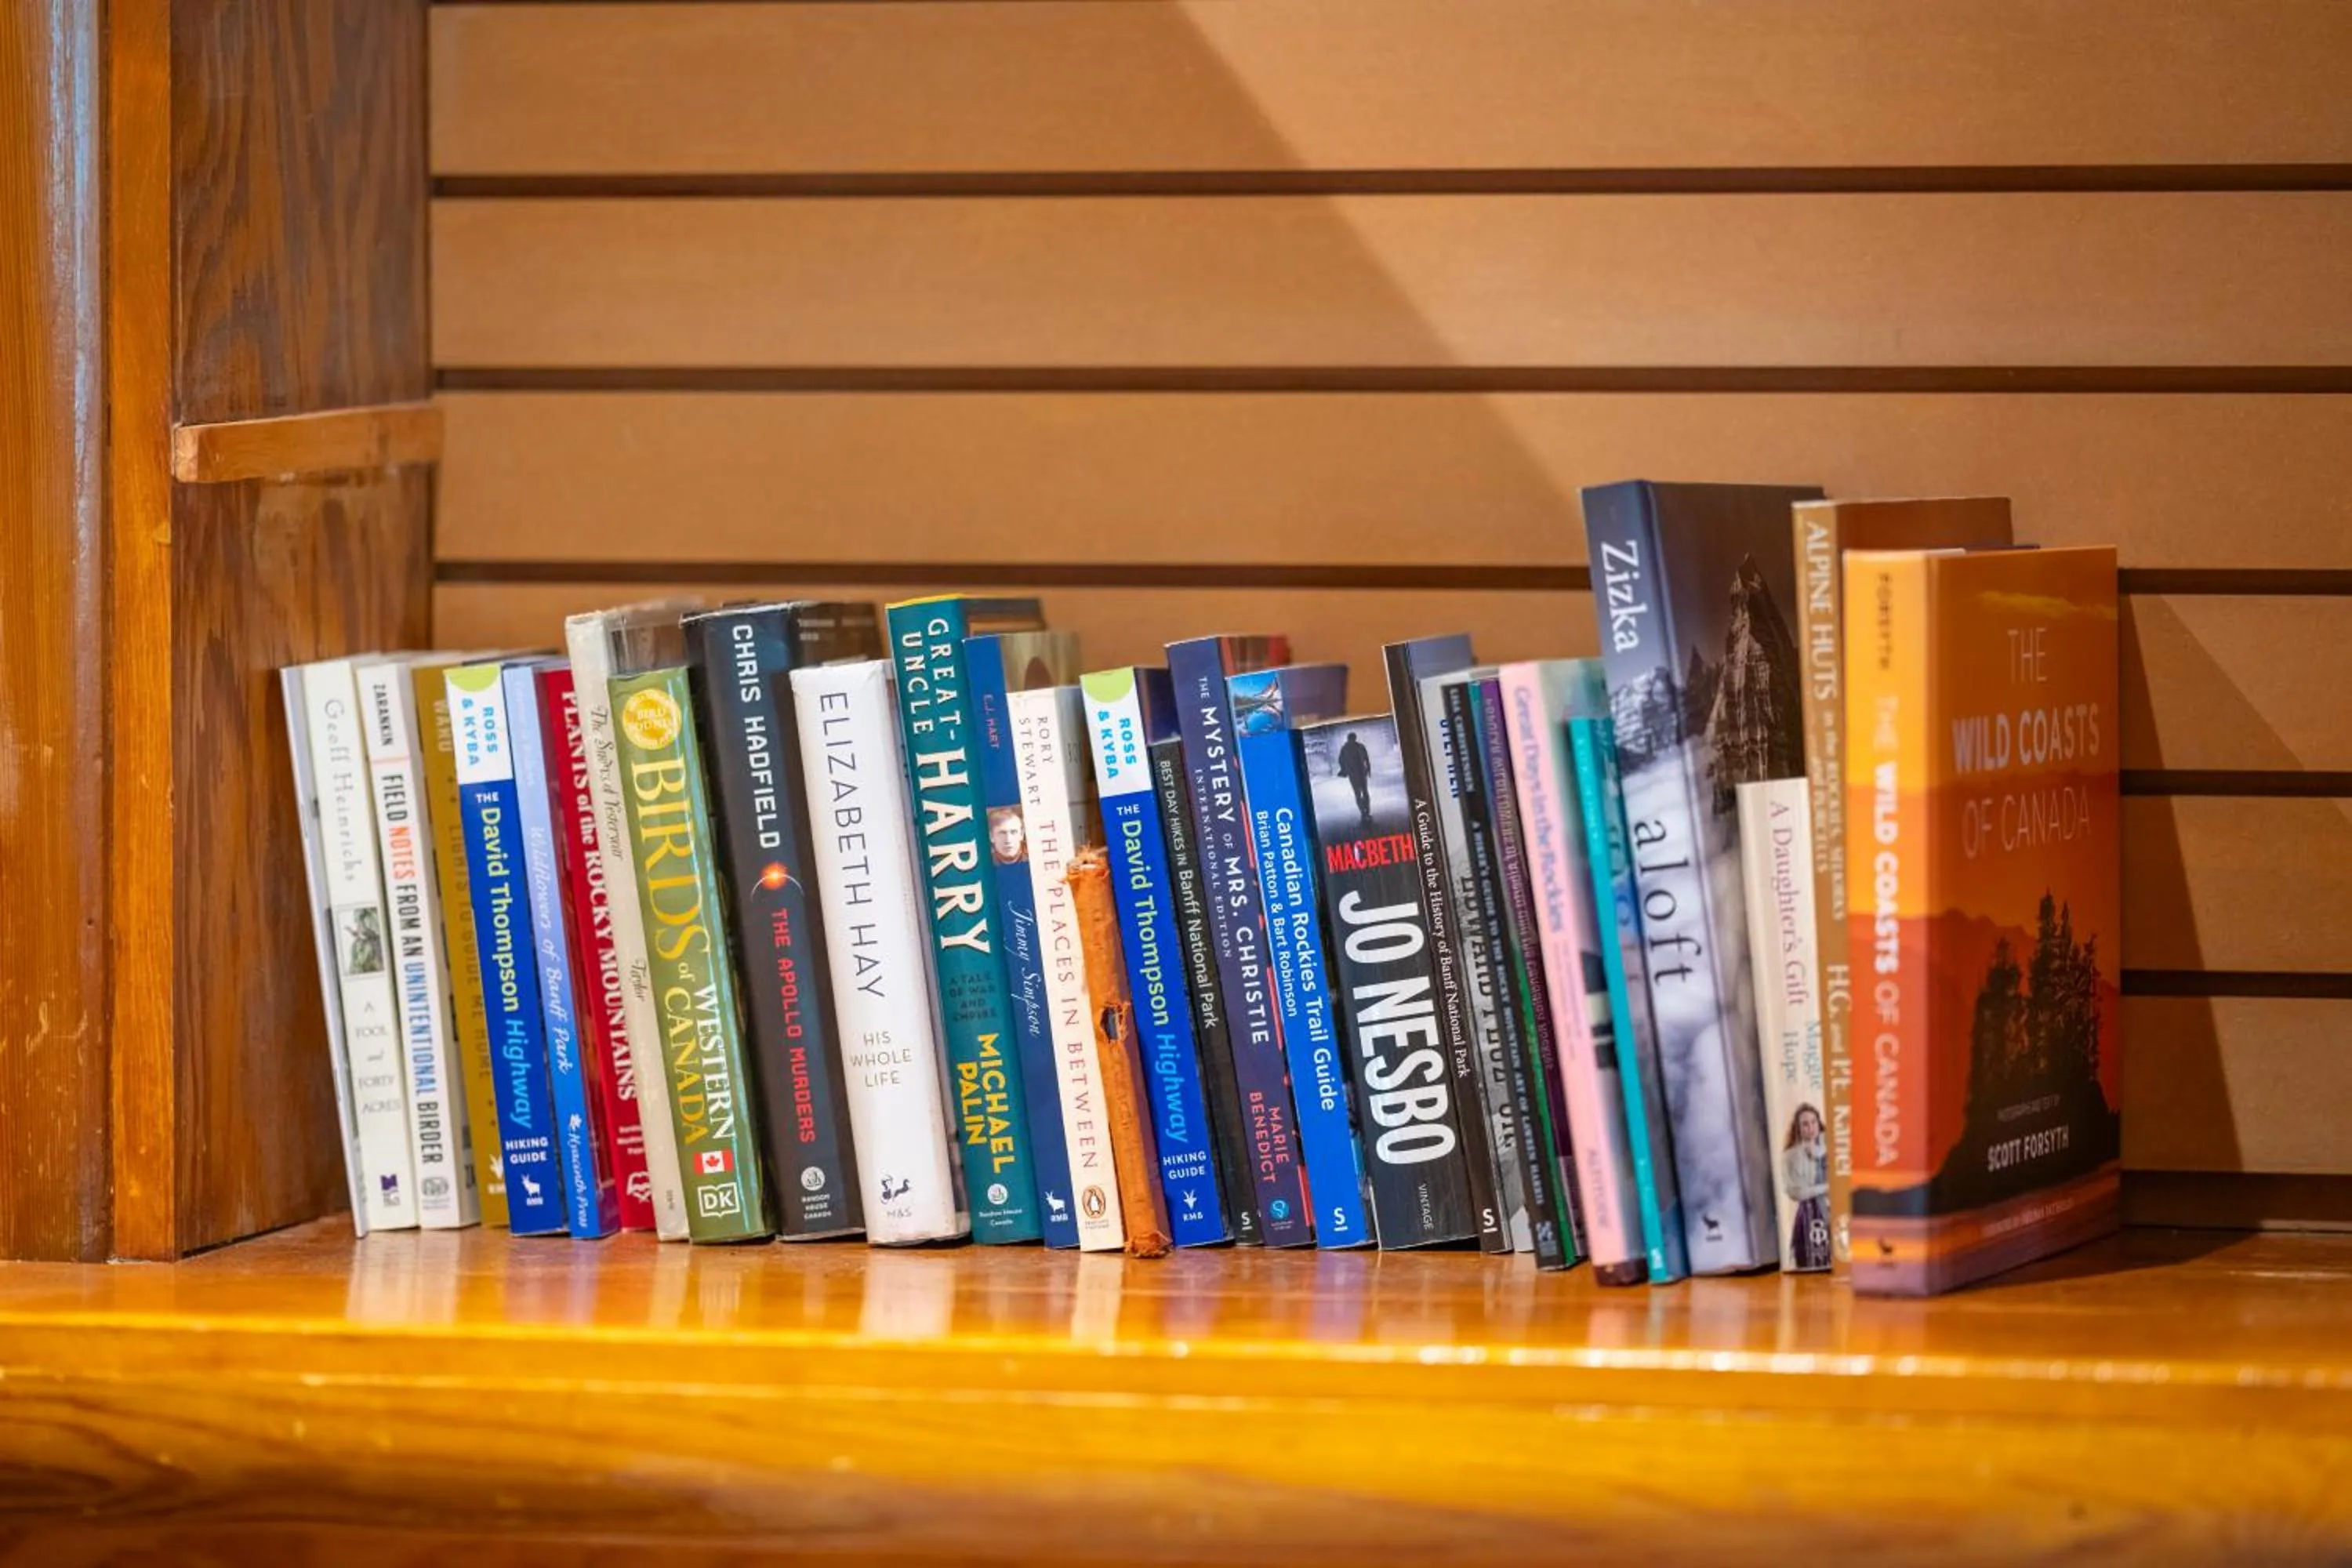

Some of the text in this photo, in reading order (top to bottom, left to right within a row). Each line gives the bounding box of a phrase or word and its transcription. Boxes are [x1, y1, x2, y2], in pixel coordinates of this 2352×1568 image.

[1600, 539, 1648, 653] Zizka
[1806, 521, 1838, 702] ALPINE HUTS
[901, 631, 935, 735] UNCLE
[927, 618, 964, 741] GREAT-
[2007, 627, 2048, 684] THE
[372, 684, 394, 746] ZARANKIN
[463, 698, 480, 766] & KYBA
[483, 706, 498, 753] ROSS
[561, 691, 588, 789] PLANTS
[732, 624, 781, 849] CHRIS HADFIELD
[986, 719, 1000, 750] HART
[1037, 717, 1054, 765] RORY
[1098, 710, 1119, 779] & KYBA
[1119, 718, 1137, 765] ROSS
[1450, 688, 1475, 793] LISA CHRISTENSEN
[1951, 702, 2100, 775] WILD COASTS
[325, 699, 362, 882] Geoff Heinrichs
[1020, 718, 1040, 806] STEWART
[382, 774, 408, 821] FIELD
[476, 792, 499, 804] THE
[577, 795, 593, 812] of
[1116, 804, 1140, 816] THE
[1962, 786, 2091, 860] OF CANADA
[389, 827, 415, 880] NOTES
[579, 815, 596, 845] the
[820, 691, 885, 998] ELIZABETH HAY
[915, 746, 993, 955] HARRY
[1197, 676, 1269, 1045] THE MYSTERY OF MRS. CHRISTIE
[1326, 833, 1419, 874] MACBETH
[1475, 831, 1490, 879] HIKER'S
[631, 753, 710, 959] BIRDS
[678, 962, 694, 982] of
[1195, 769, 1232, 958] INTERNATIONAL EDITION
[395, 884, 421, 931] FROM
[584, 851, 613, 938] ROCKY
[1160, 760, 1219, 1029] BEST DAY HIKES IN Banff National Park
[1255, 810, 1298, 1018] Brian Patton & Bart Robinson
[1482, 880, 1496, 916] GUIDE
[1633, 819, 1701, 986] aloft
[1769, 801, 1804, 1007] A Daughter's Gift
[401, 935, 423, 956] AN
[530, 826, 573, 1076] Wildflowers of Banff Park
[1414, 798, 1472, 1079] A Guide to the History of Banff National Park
[1489, 920, 1499, 936] TO
[1492, 938, 1504, 961] THE
[1872, 695, 1901, 1168] THE WILD COASTS OF CANADA
[481, 808, 532, 1129] David Thompson Highway
[630, 958, 646, 1002] Taylor
[949, 984, 997, 995] OF WAR
[1004, 900, 1041, 1037] Jimmy Simpson
[1121, 820, 1189, 1144] David Thompson Highway
[1276, 808, 1335, 1112] Canadian Rockies Trail Guide
[1497, 964, 1511, 1003] ROCKY
[597, 947, 637, 1102] MOUNTAINS
[953, 1010, 997, 1022] EMPIRE
[960, 1000, 986, 1009] AND
[1040, 822, 1098, 1169] THE PLACES IN BETWEEN
[355, 1026, 387, 1036] FOOL
[404, 962, 436, 1097] UNINTENTIONAL
[771, 909, 816, 1144] THE APOLLO MURDERS
[863, 1031, 891, 1046] HIS
[1338, 890, 1457, 1165] JO NESBO
[1504, 1007, 1522, 1069] MOUNTAIN
[1781, 1031, 1798, 1083] Hope
[1805, 1019, 1822, 1091] Maggie
[358, 1075, 394, 1089] FORTY
[665, 987, 710, 1144] CANADA
[693, 983, 735, 1140] WESTERN
[850, 1048, 913, 1068] WHOLE
[864, 1071, 902, 1088] LIFE
[1514, 1071, 1526, 1094] ART
[361, 1100, 401, 1114] ACRES
[417, 1102, 443, 1165] BIRDER
[956, 1061, 988, 1147] PALIN
[977, 1033, 1016, 1174] MICHAEL
[1518, 1097, 1529, 1112] OF
[505, 1137, 549, 1150] HIKING
[510, 1152, 547, 1164] GUIDE
[568, 1133, 583, 1194] Hyacinth
[1163, 1151, 1207, 1167] HIKING
[1249, 1091, 1276, 1184] BENEDICT
[1267, 1106, 1290, 1164] MARIE
[1521, 1115, 1537, 1163] LAWREN
[1987, 1123, 2070, 1173] SCOTT FORSYTH
[704, 1190, 733, 1210] DK
[1168, 1166, 1205, 1180] GUIDE
[1530, 1164, 1545, 1206] HARRIS
[887, 1207, 913, 1218] M&S
[1183, 1211, 1203, 1222] RMB
[1417, 1183, 1435, 1230] VINTAGE
